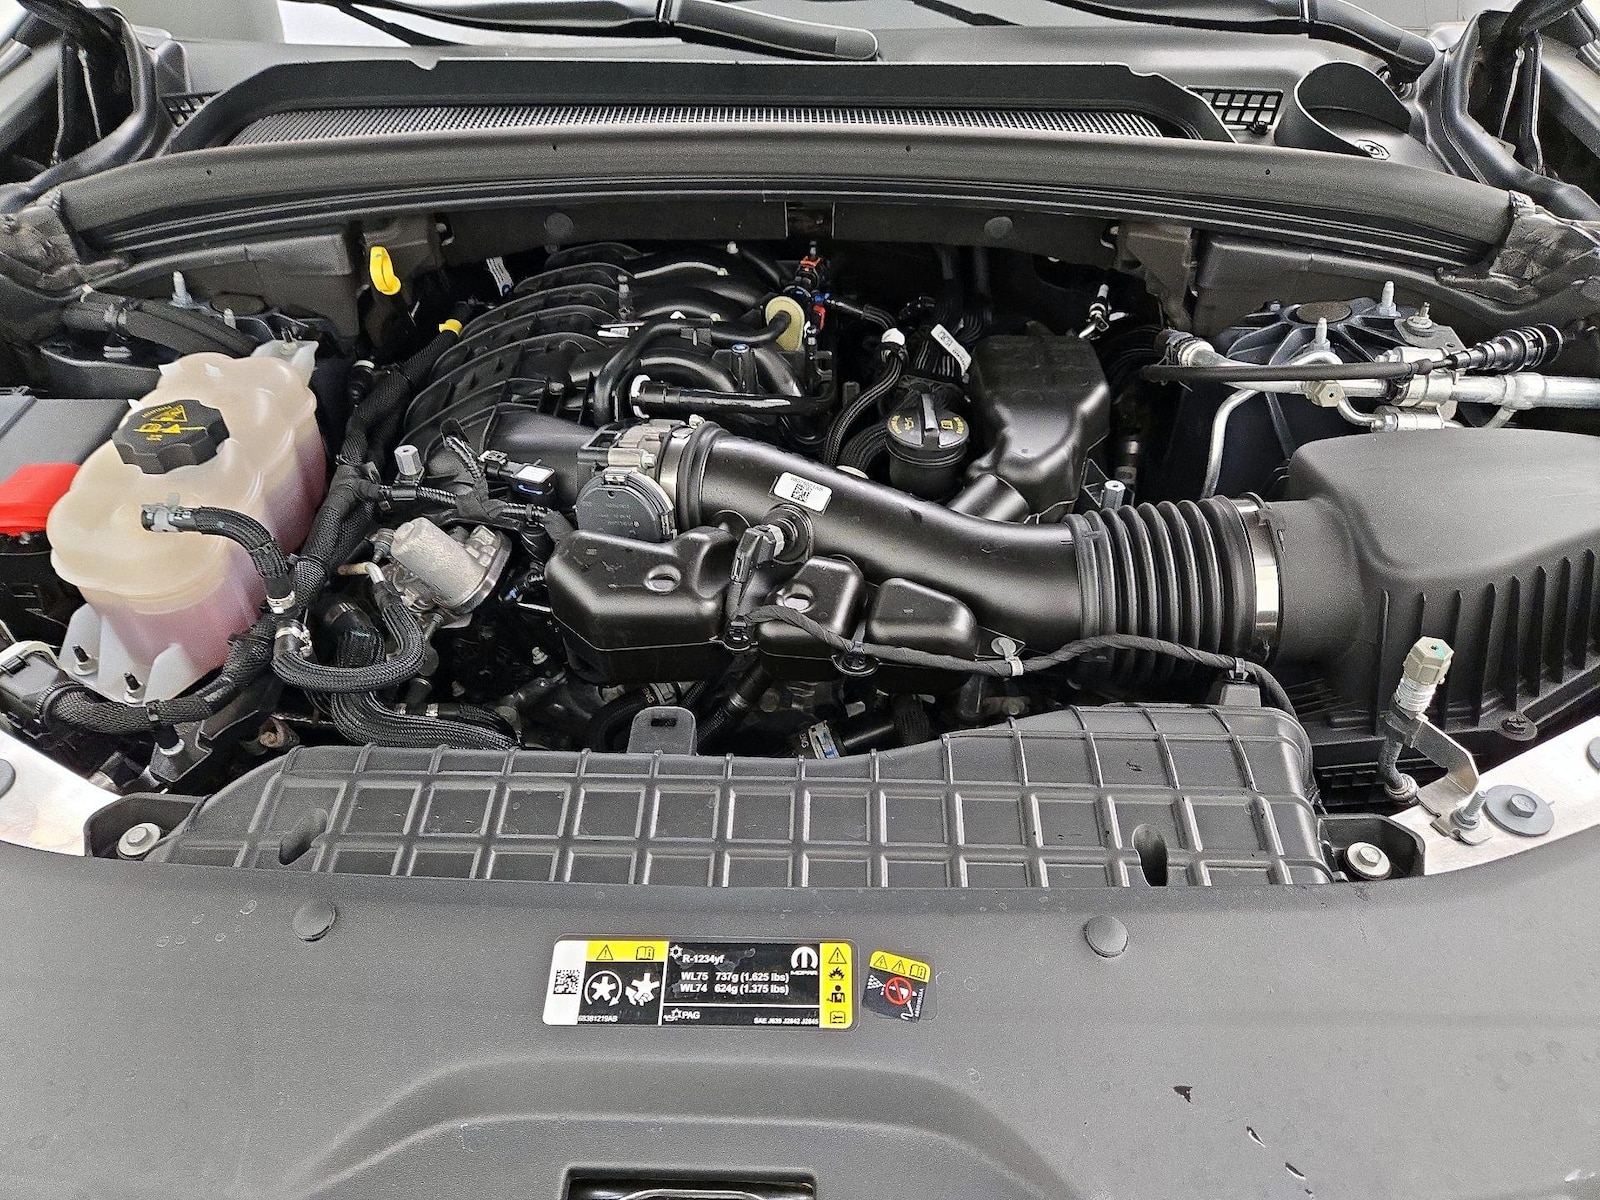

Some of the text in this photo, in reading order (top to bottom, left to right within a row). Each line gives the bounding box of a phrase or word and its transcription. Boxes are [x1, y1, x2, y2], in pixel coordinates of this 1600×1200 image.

[682, 954, 725, 966] R-1234yf
[681, 971, 790, 984] WL75 737g (1.625 lbs)
[680, 983, 790, 996] WL74 624g (1.375 lbs)
[682, 1010, 701, 1020] PAG
